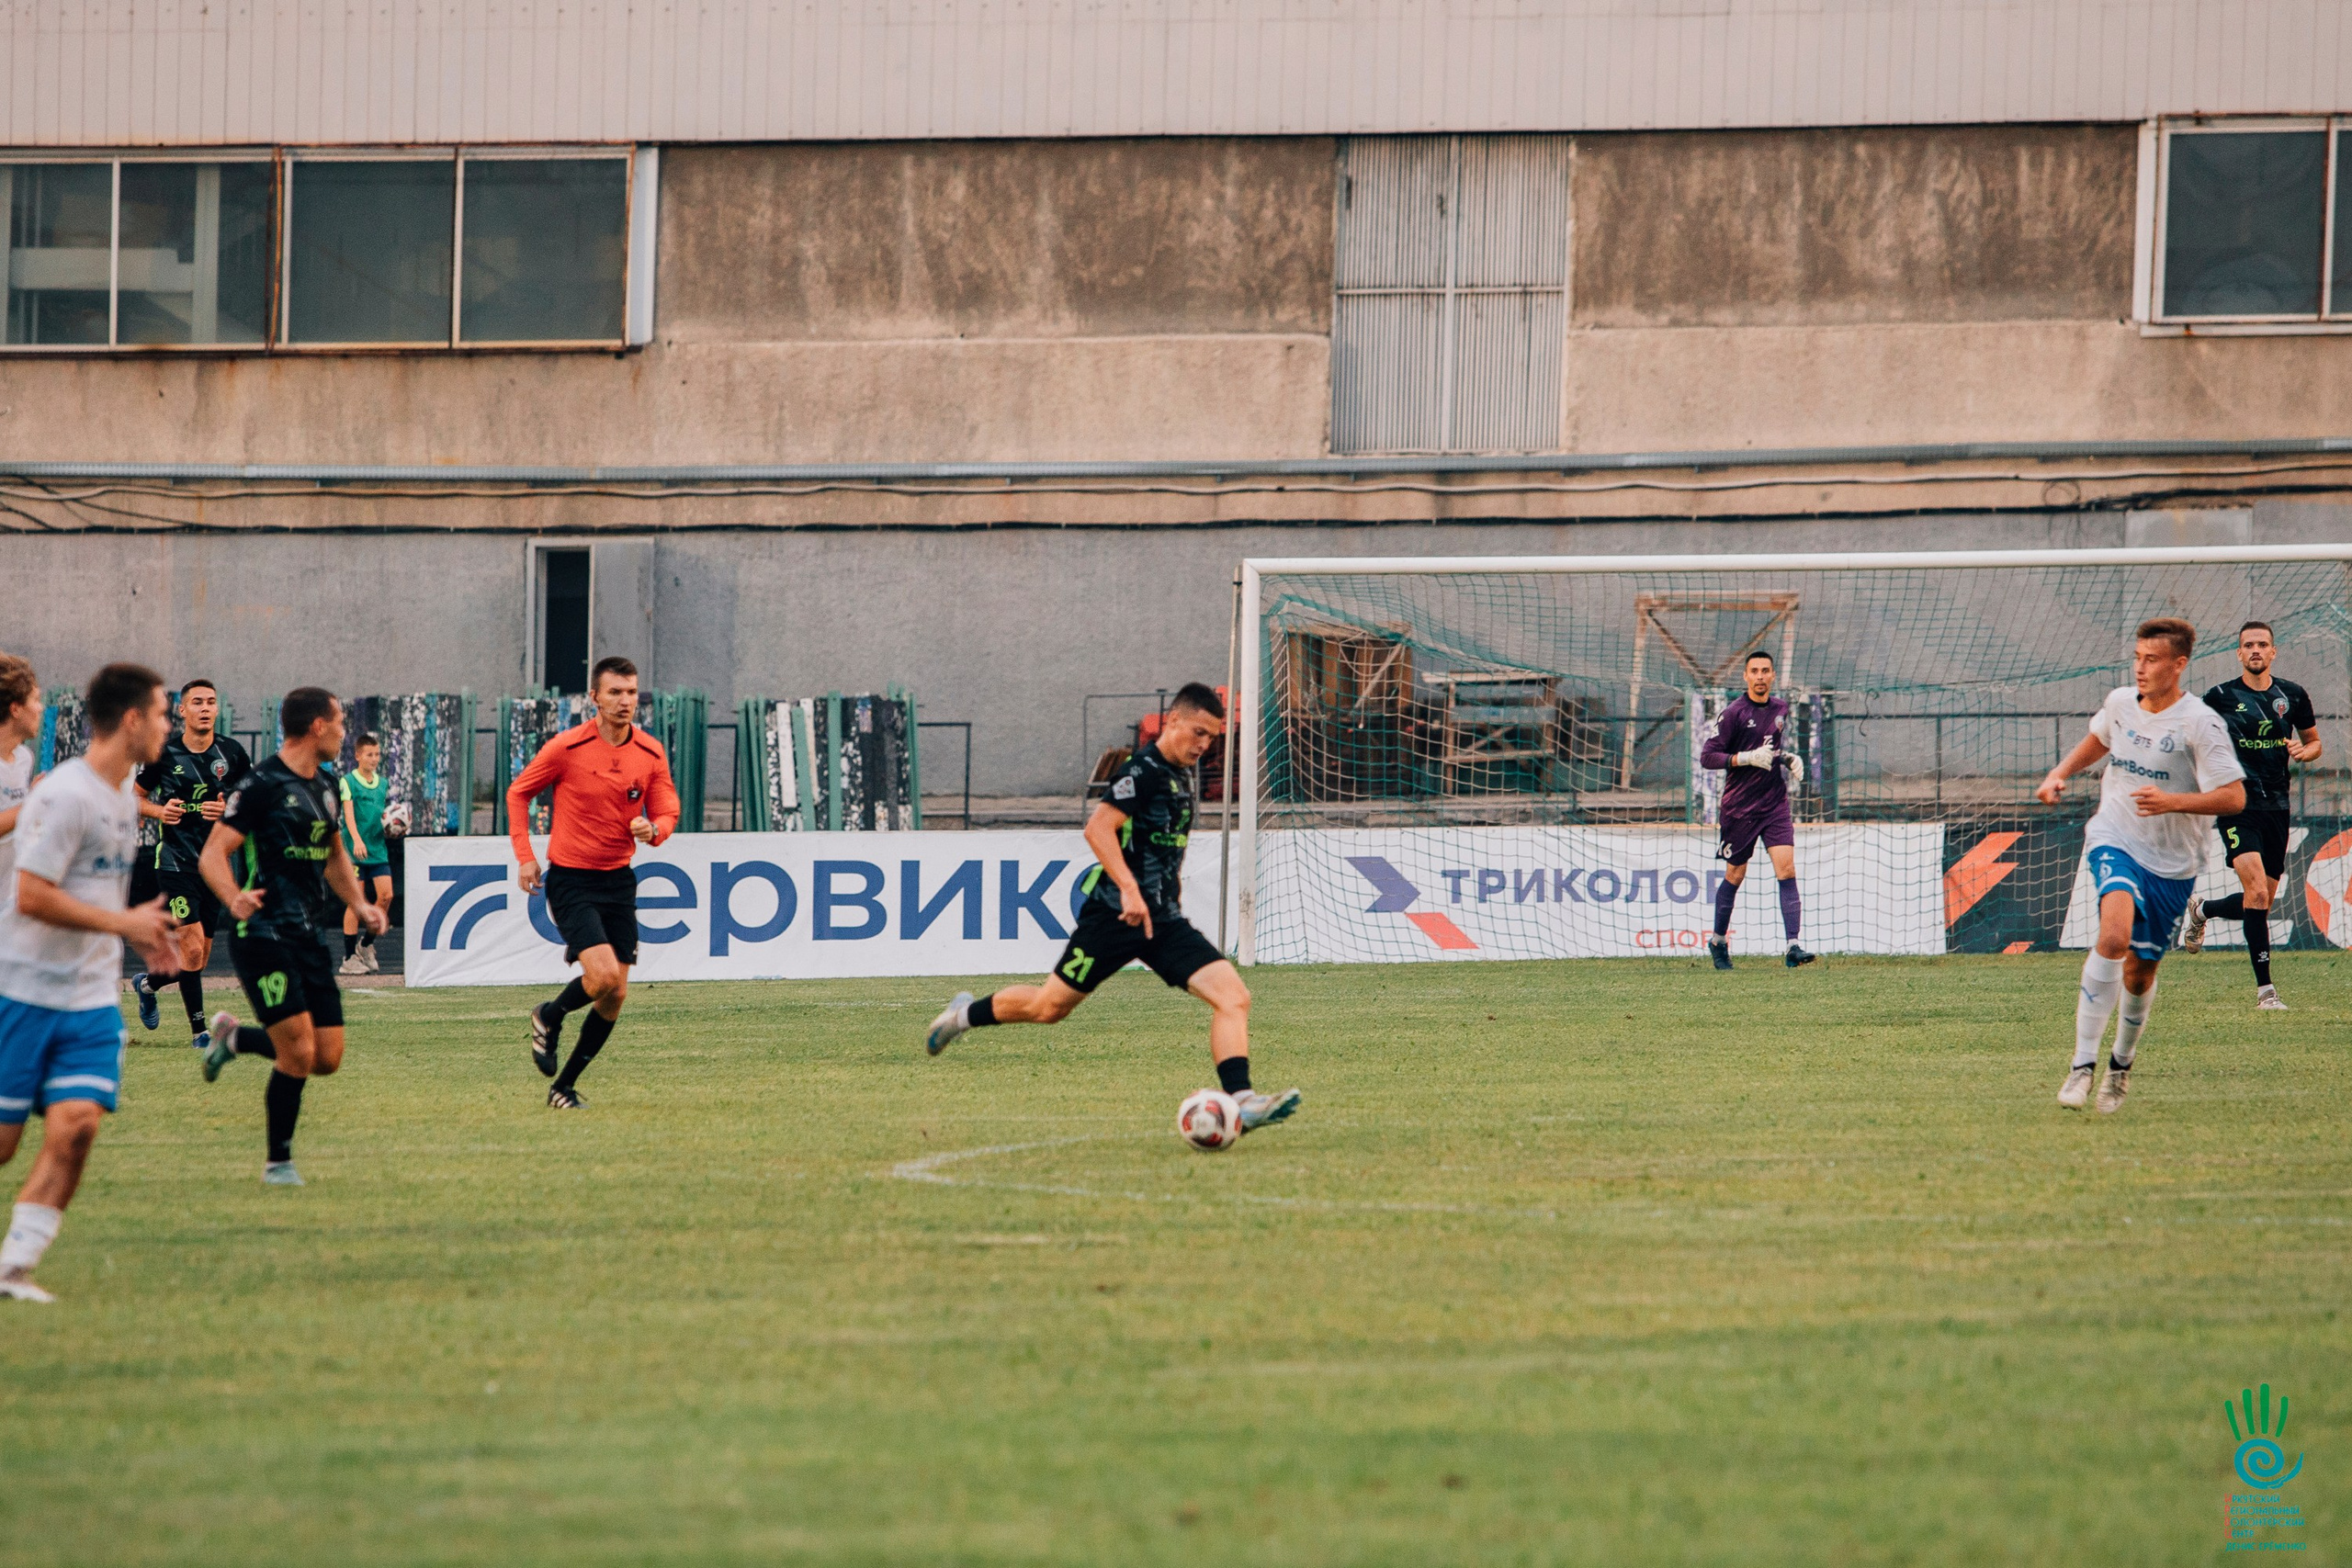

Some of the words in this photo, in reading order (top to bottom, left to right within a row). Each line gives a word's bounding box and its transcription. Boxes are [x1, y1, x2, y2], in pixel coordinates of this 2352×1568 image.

[2227, 827, 2240, 849] 5
[169, 896, 190, 919] 18
[1062, 947, 1094, 984] 21
[257, 971, 288, 1008] 19
